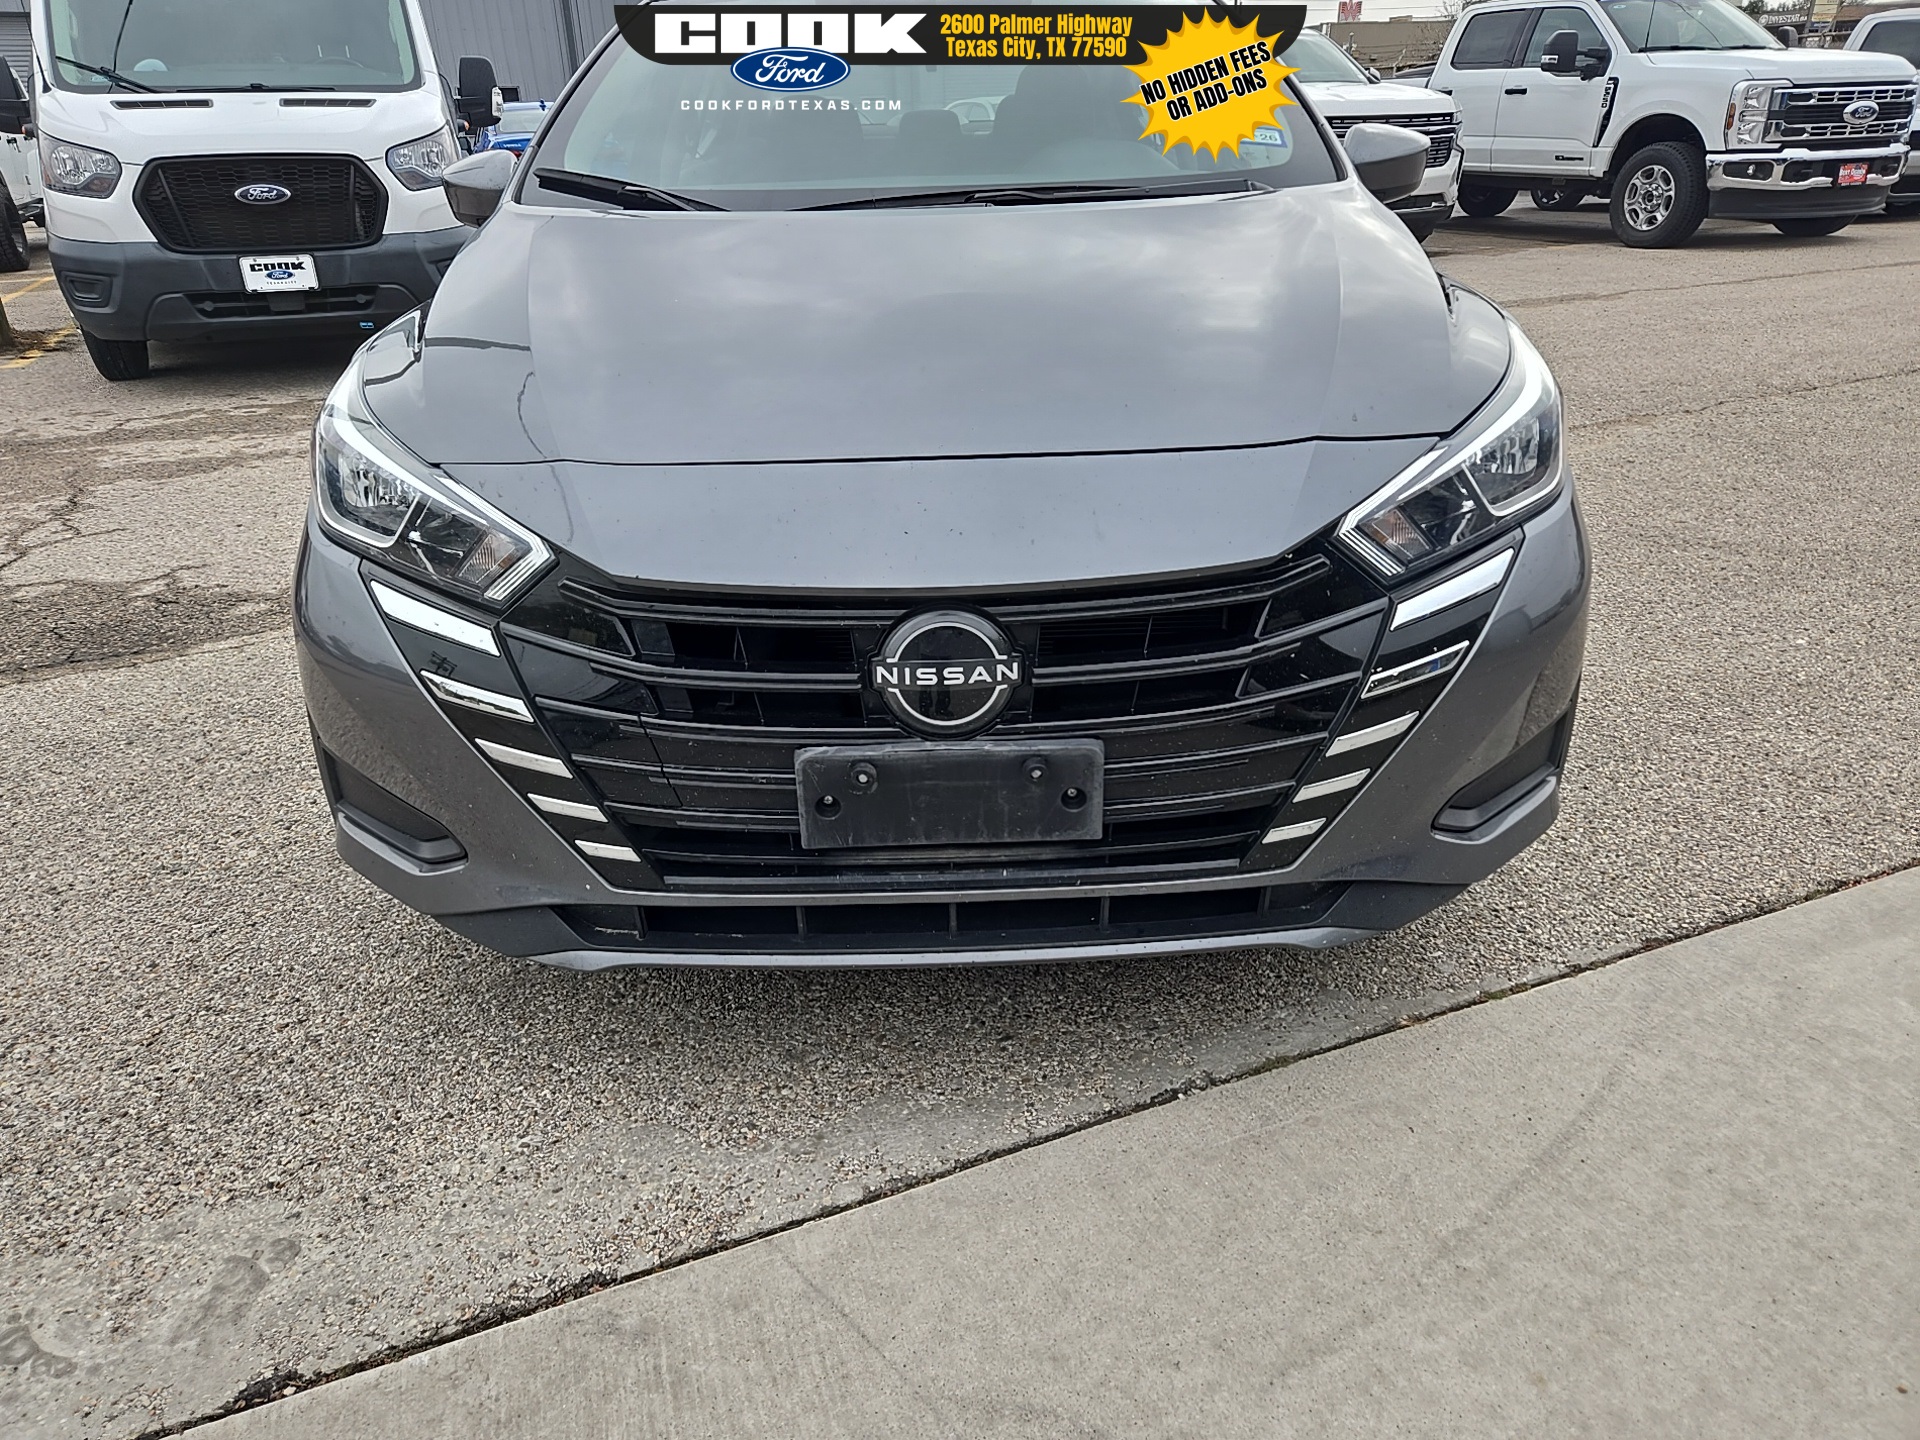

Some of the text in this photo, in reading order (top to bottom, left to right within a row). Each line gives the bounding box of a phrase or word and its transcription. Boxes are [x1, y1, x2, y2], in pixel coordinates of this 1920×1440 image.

[247, 187, 278, 200] Ford
[249, 261, 306, 272] COOK
[876, 662, 1018, 685] NISSAN
